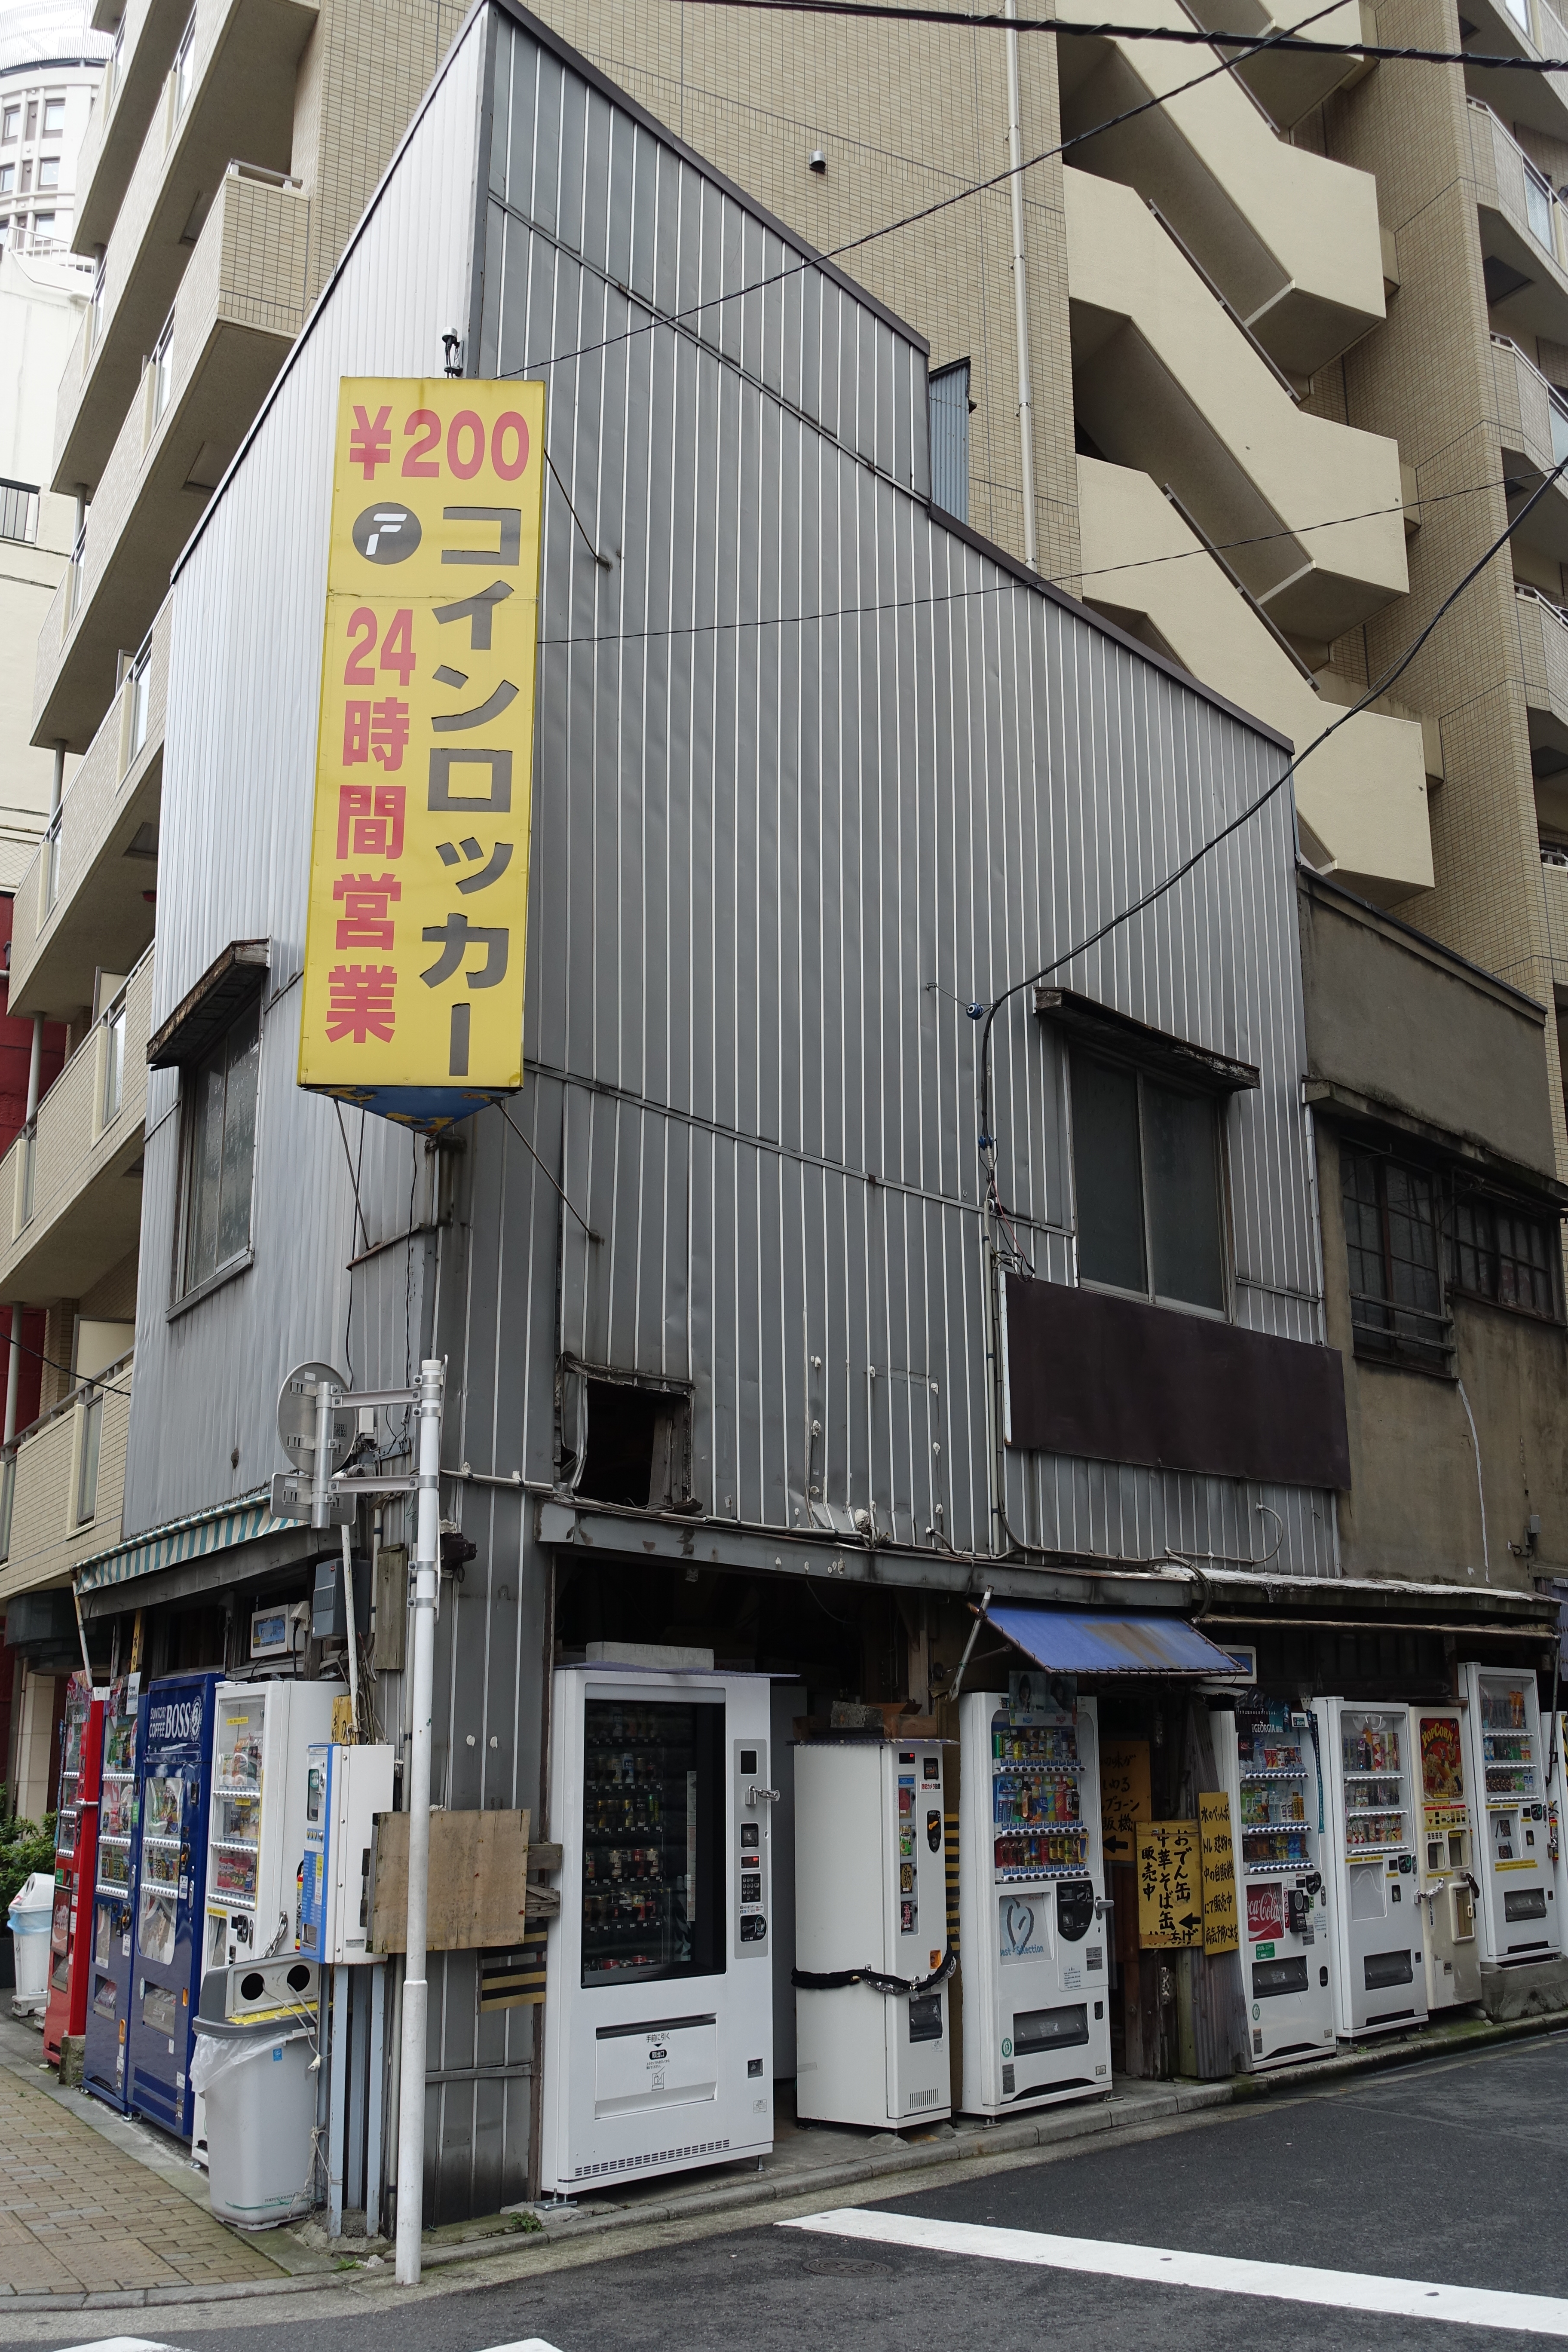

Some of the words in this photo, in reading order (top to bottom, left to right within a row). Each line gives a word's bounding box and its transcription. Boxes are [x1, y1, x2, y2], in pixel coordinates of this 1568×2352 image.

[349, 405, 530, 482] ¥200
[419, 505, 521, 1076] コインロッカー
[325, 606, 416, 1045] 24時間営業
[150, 1706, 167, 1720] SUNTORY
[165, 1702, 191, 1738] BOSS
[149, 1722, 165, 1738] COFFEE
[1254, 1722, 1276, 1733] GEORGIA
[1421, 1723, 1453, 1749] POPCORN
[1101, 1751, 1136, 1769] の味が
[1102, 1795, 1140, 1812] プコーン
[1142, 1845, 1158, 1902] 販売中
[1174, 1828, 1192, 1902] おでん缶
[1204, 1860, 1234, 1883] 中の自販機
[1157, 1828, 1176, 1930] 中華そば缶
[1204, 1891, 1232, 1915] にて販売中
[1016, 1944, 1044, 1955] Selection
[646, 2033, 670, 2043] 手前に引く
[652, 2050, 665, 2058] 取出口
